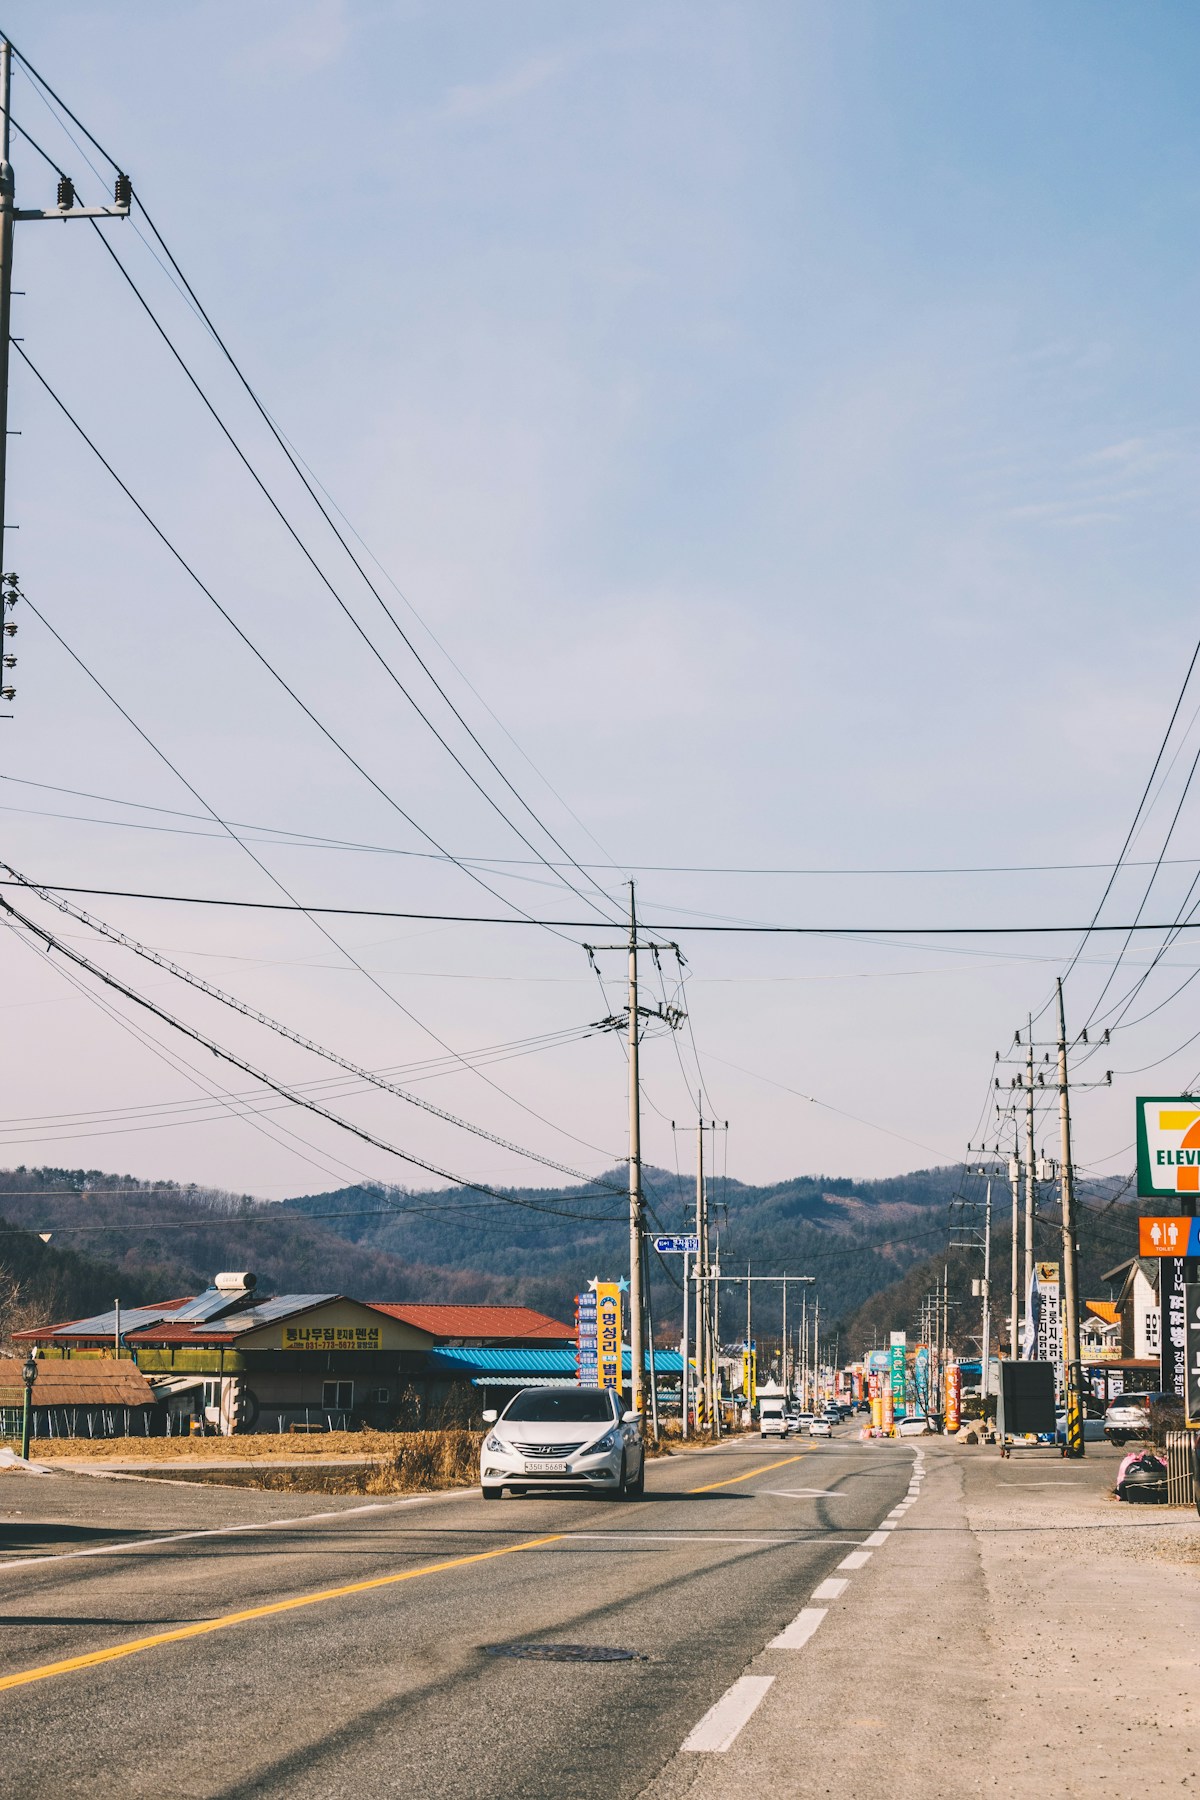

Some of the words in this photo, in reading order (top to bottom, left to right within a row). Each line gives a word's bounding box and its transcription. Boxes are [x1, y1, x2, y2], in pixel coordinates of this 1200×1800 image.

[1157, 1150, 1200, 1165] ELEV
[287, 1328, 335, 1341] 통나무집
[602, 1313, 617, 1353] 명성리
[892, 1347, 904, 1396] 조은스키
[545, 1463, 563, 1471] 5668
